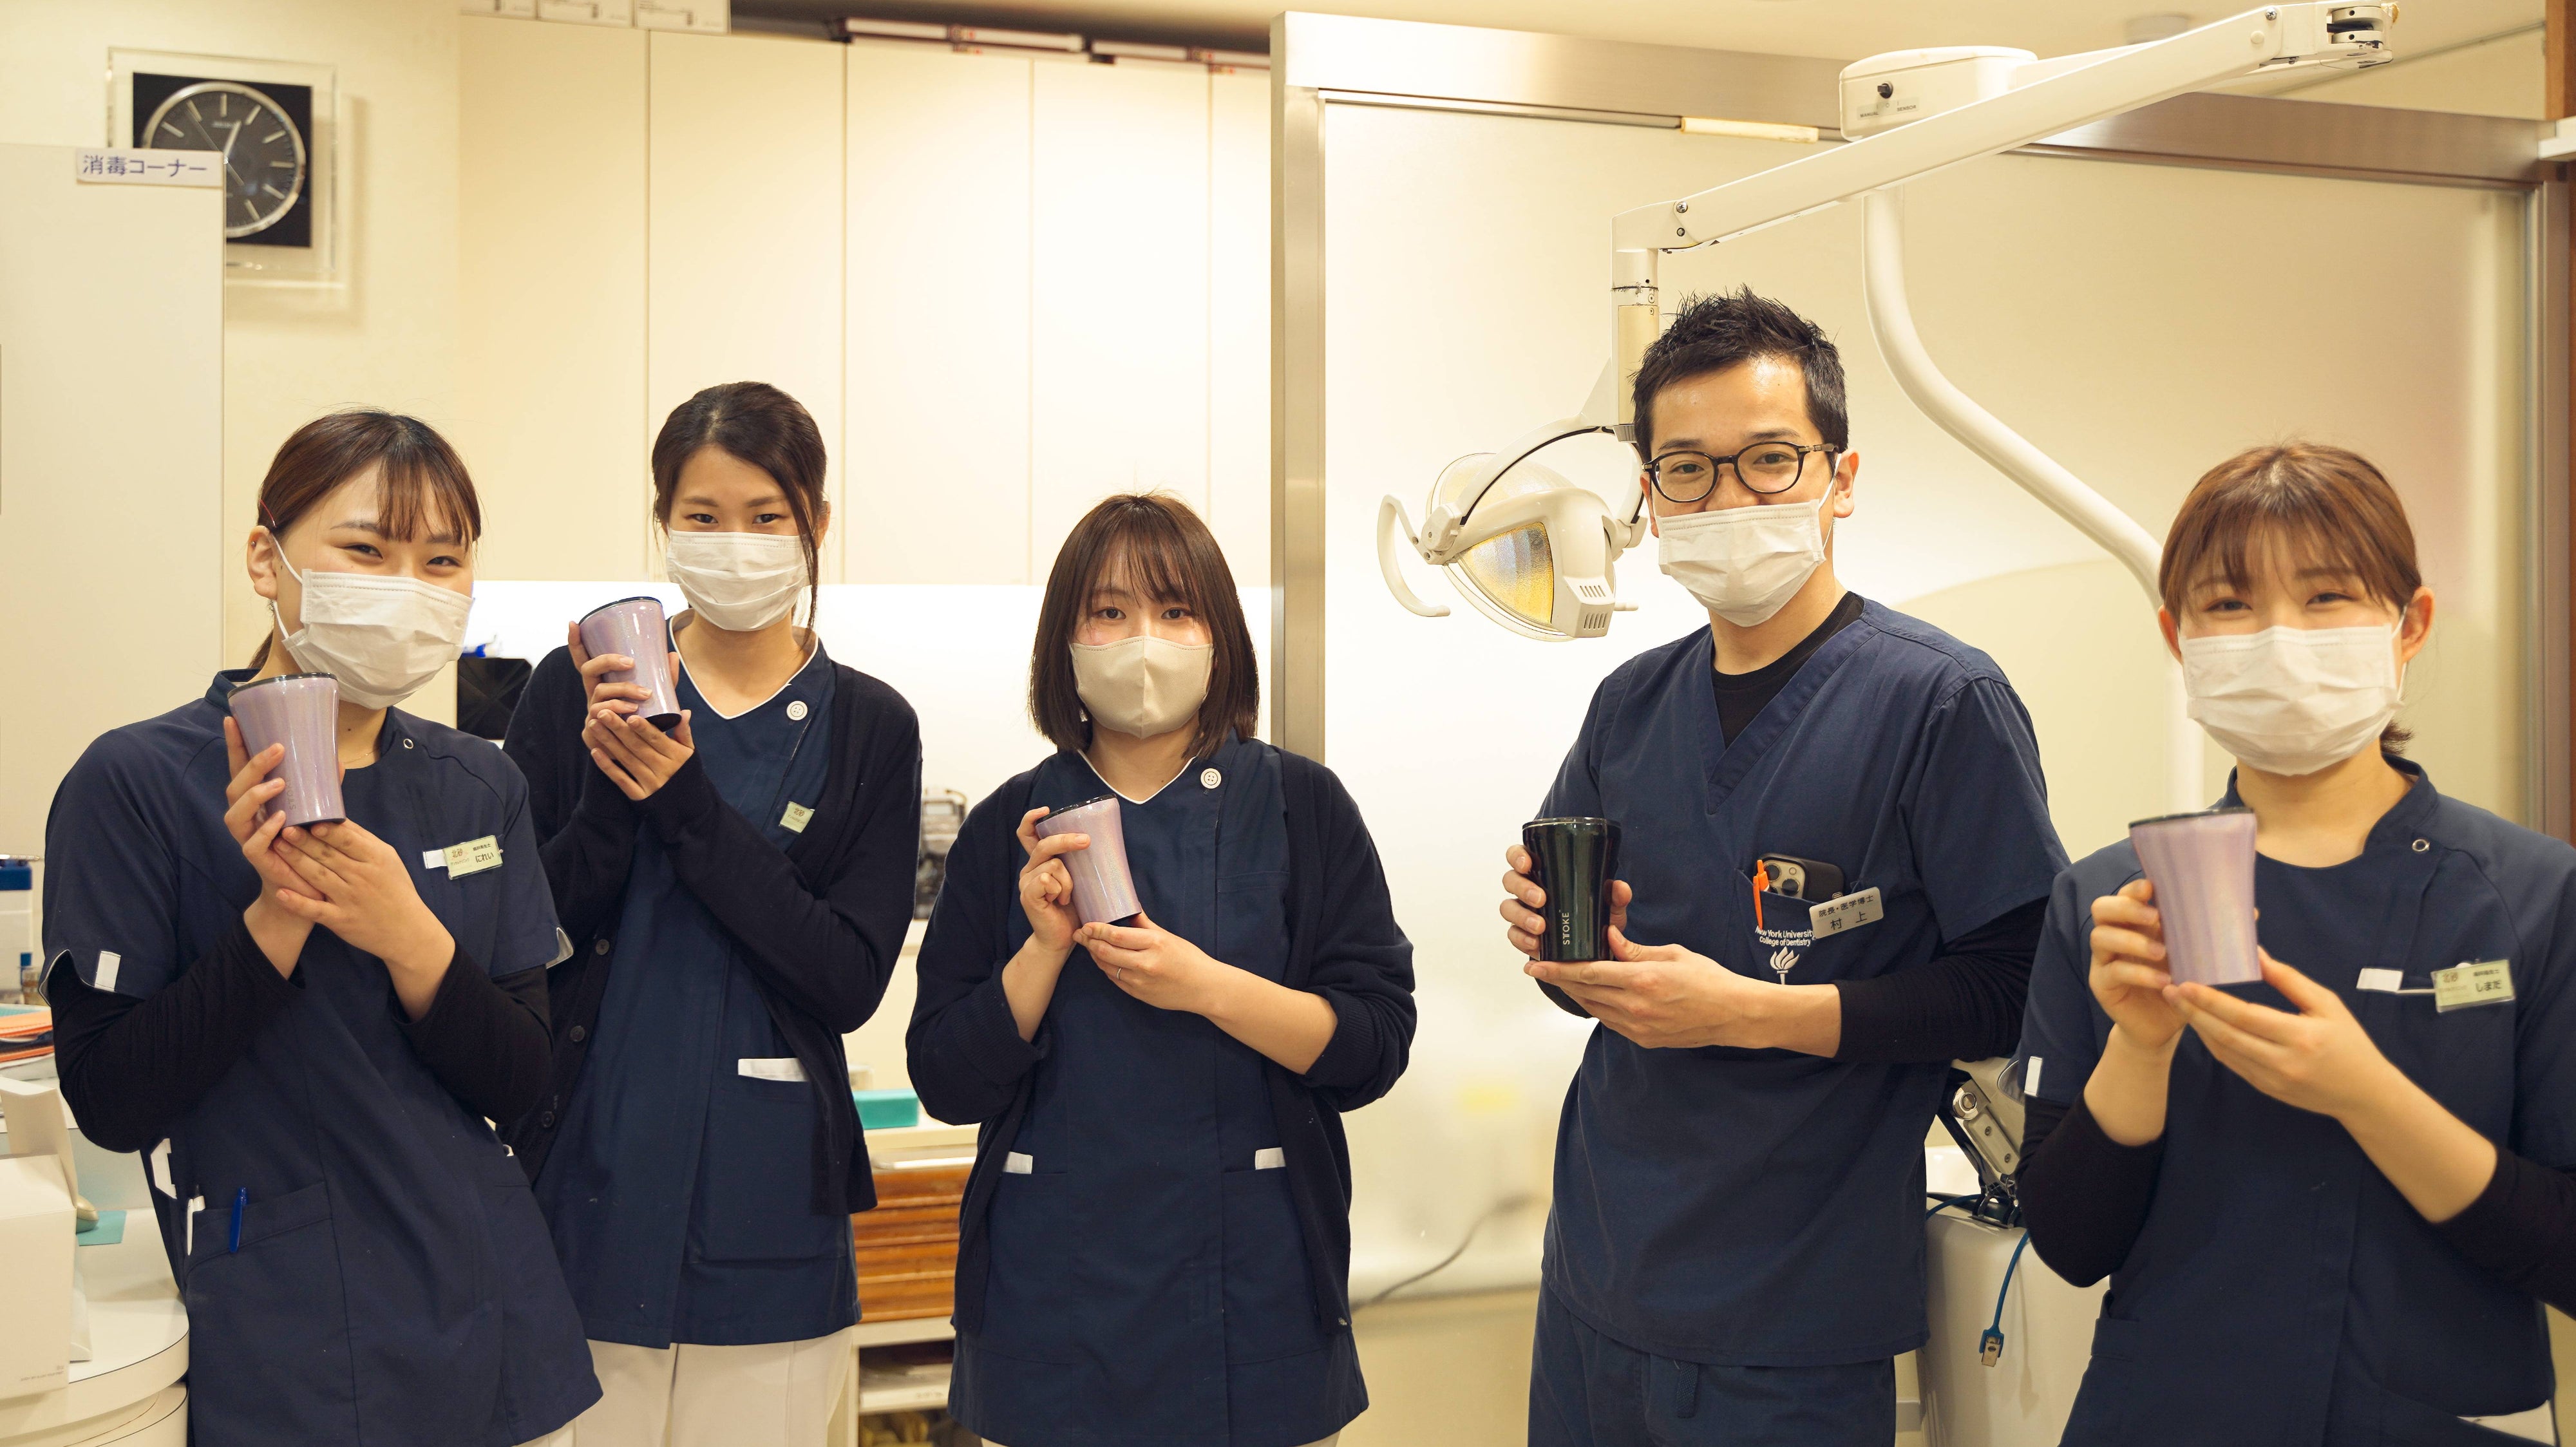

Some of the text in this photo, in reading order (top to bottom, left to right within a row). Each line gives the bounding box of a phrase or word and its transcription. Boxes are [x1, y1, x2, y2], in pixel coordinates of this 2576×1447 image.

[83, 155, 207, 177] 消毒コーナー
[475, 852, 494, 863] にれい
[1819, 894, 1874, 917] 院長・医学博士
[1755, 925, 1815, 940] New York University
[1759, 936, 1779, 947] College
[1786, 939, 1811, 947] Dentistry
[2476, 979, 2502, 992] しまだ
